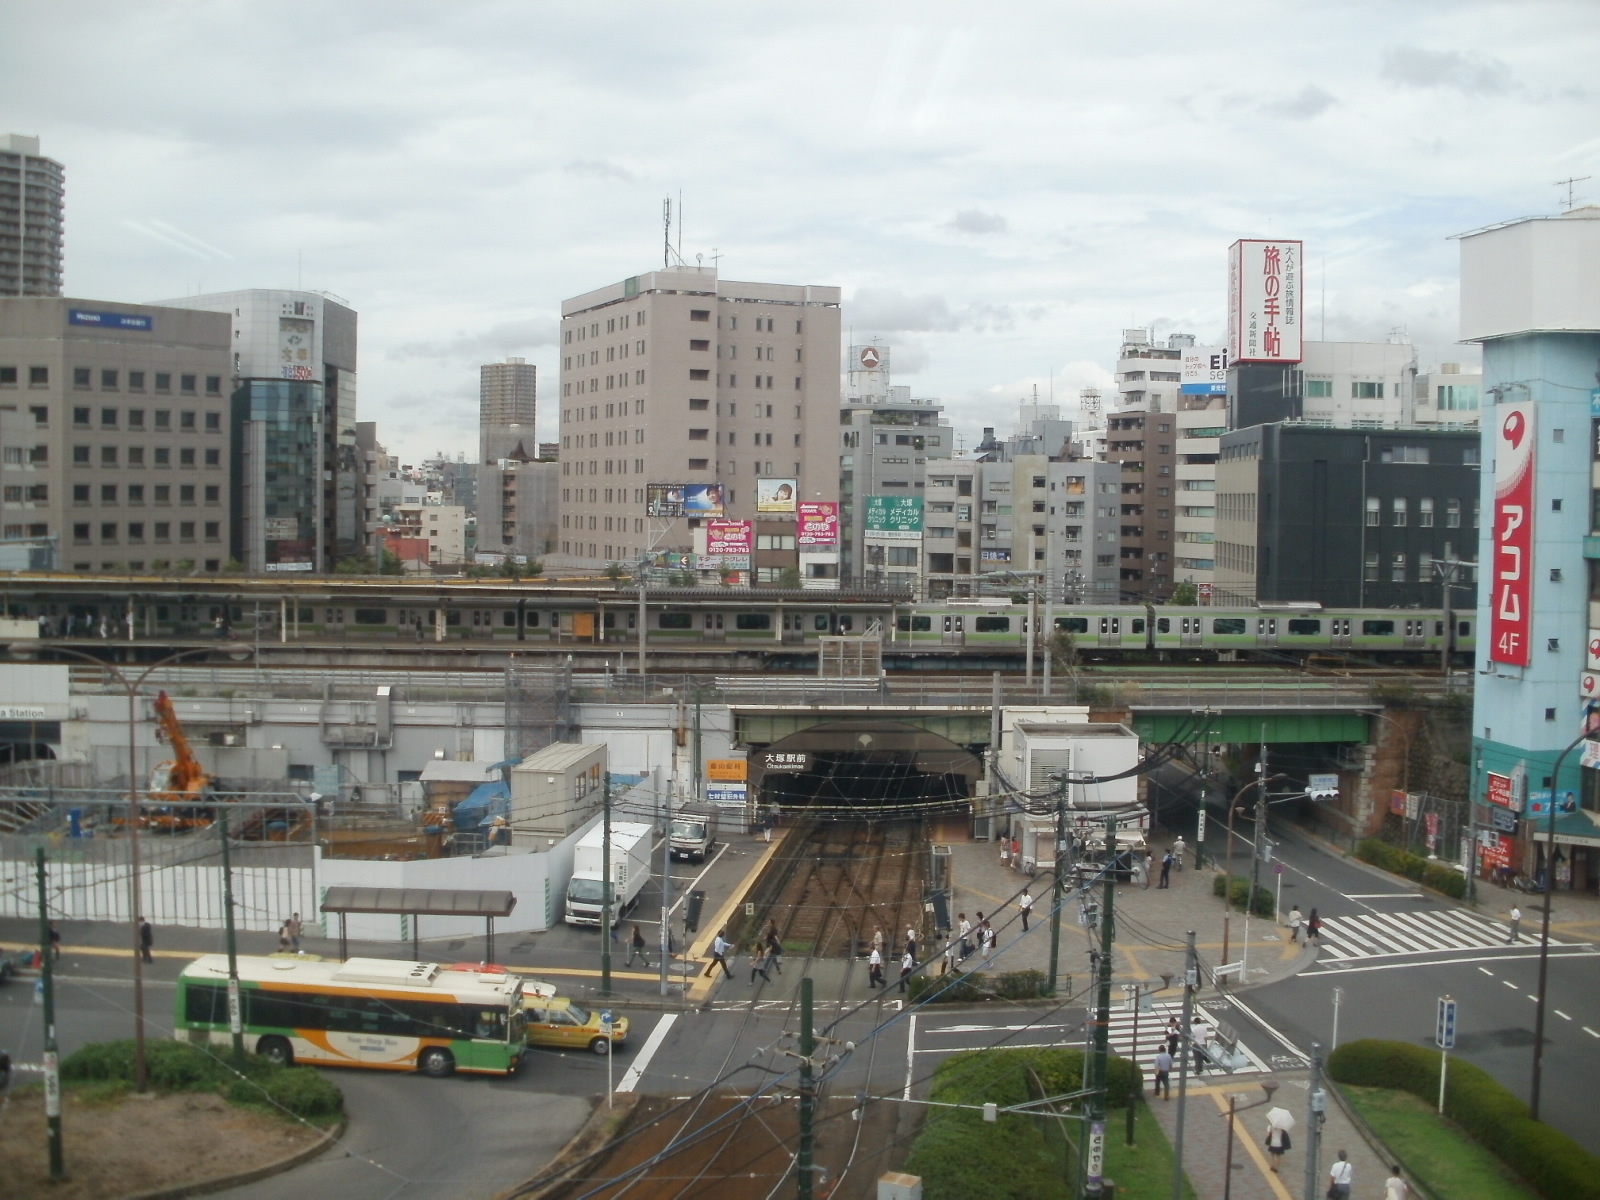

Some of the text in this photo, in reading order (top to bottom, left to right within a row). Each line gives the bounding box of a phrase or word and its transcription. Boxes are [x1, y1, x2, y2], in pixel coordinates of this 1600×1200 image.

[1264, 245, 1281, 357] 旅の手帖
[900, 499, 913, 507] 大塚
[890, 508, 919, 516] メディカル
[890, 516, 918, 524] クリニック
[1499, 505, 1523, 622] アコム
[1499, 631, 1520, 655] 4F
[10, 709, 44, 718] Station
[765, 754, 806, 763] 大塚駅前
